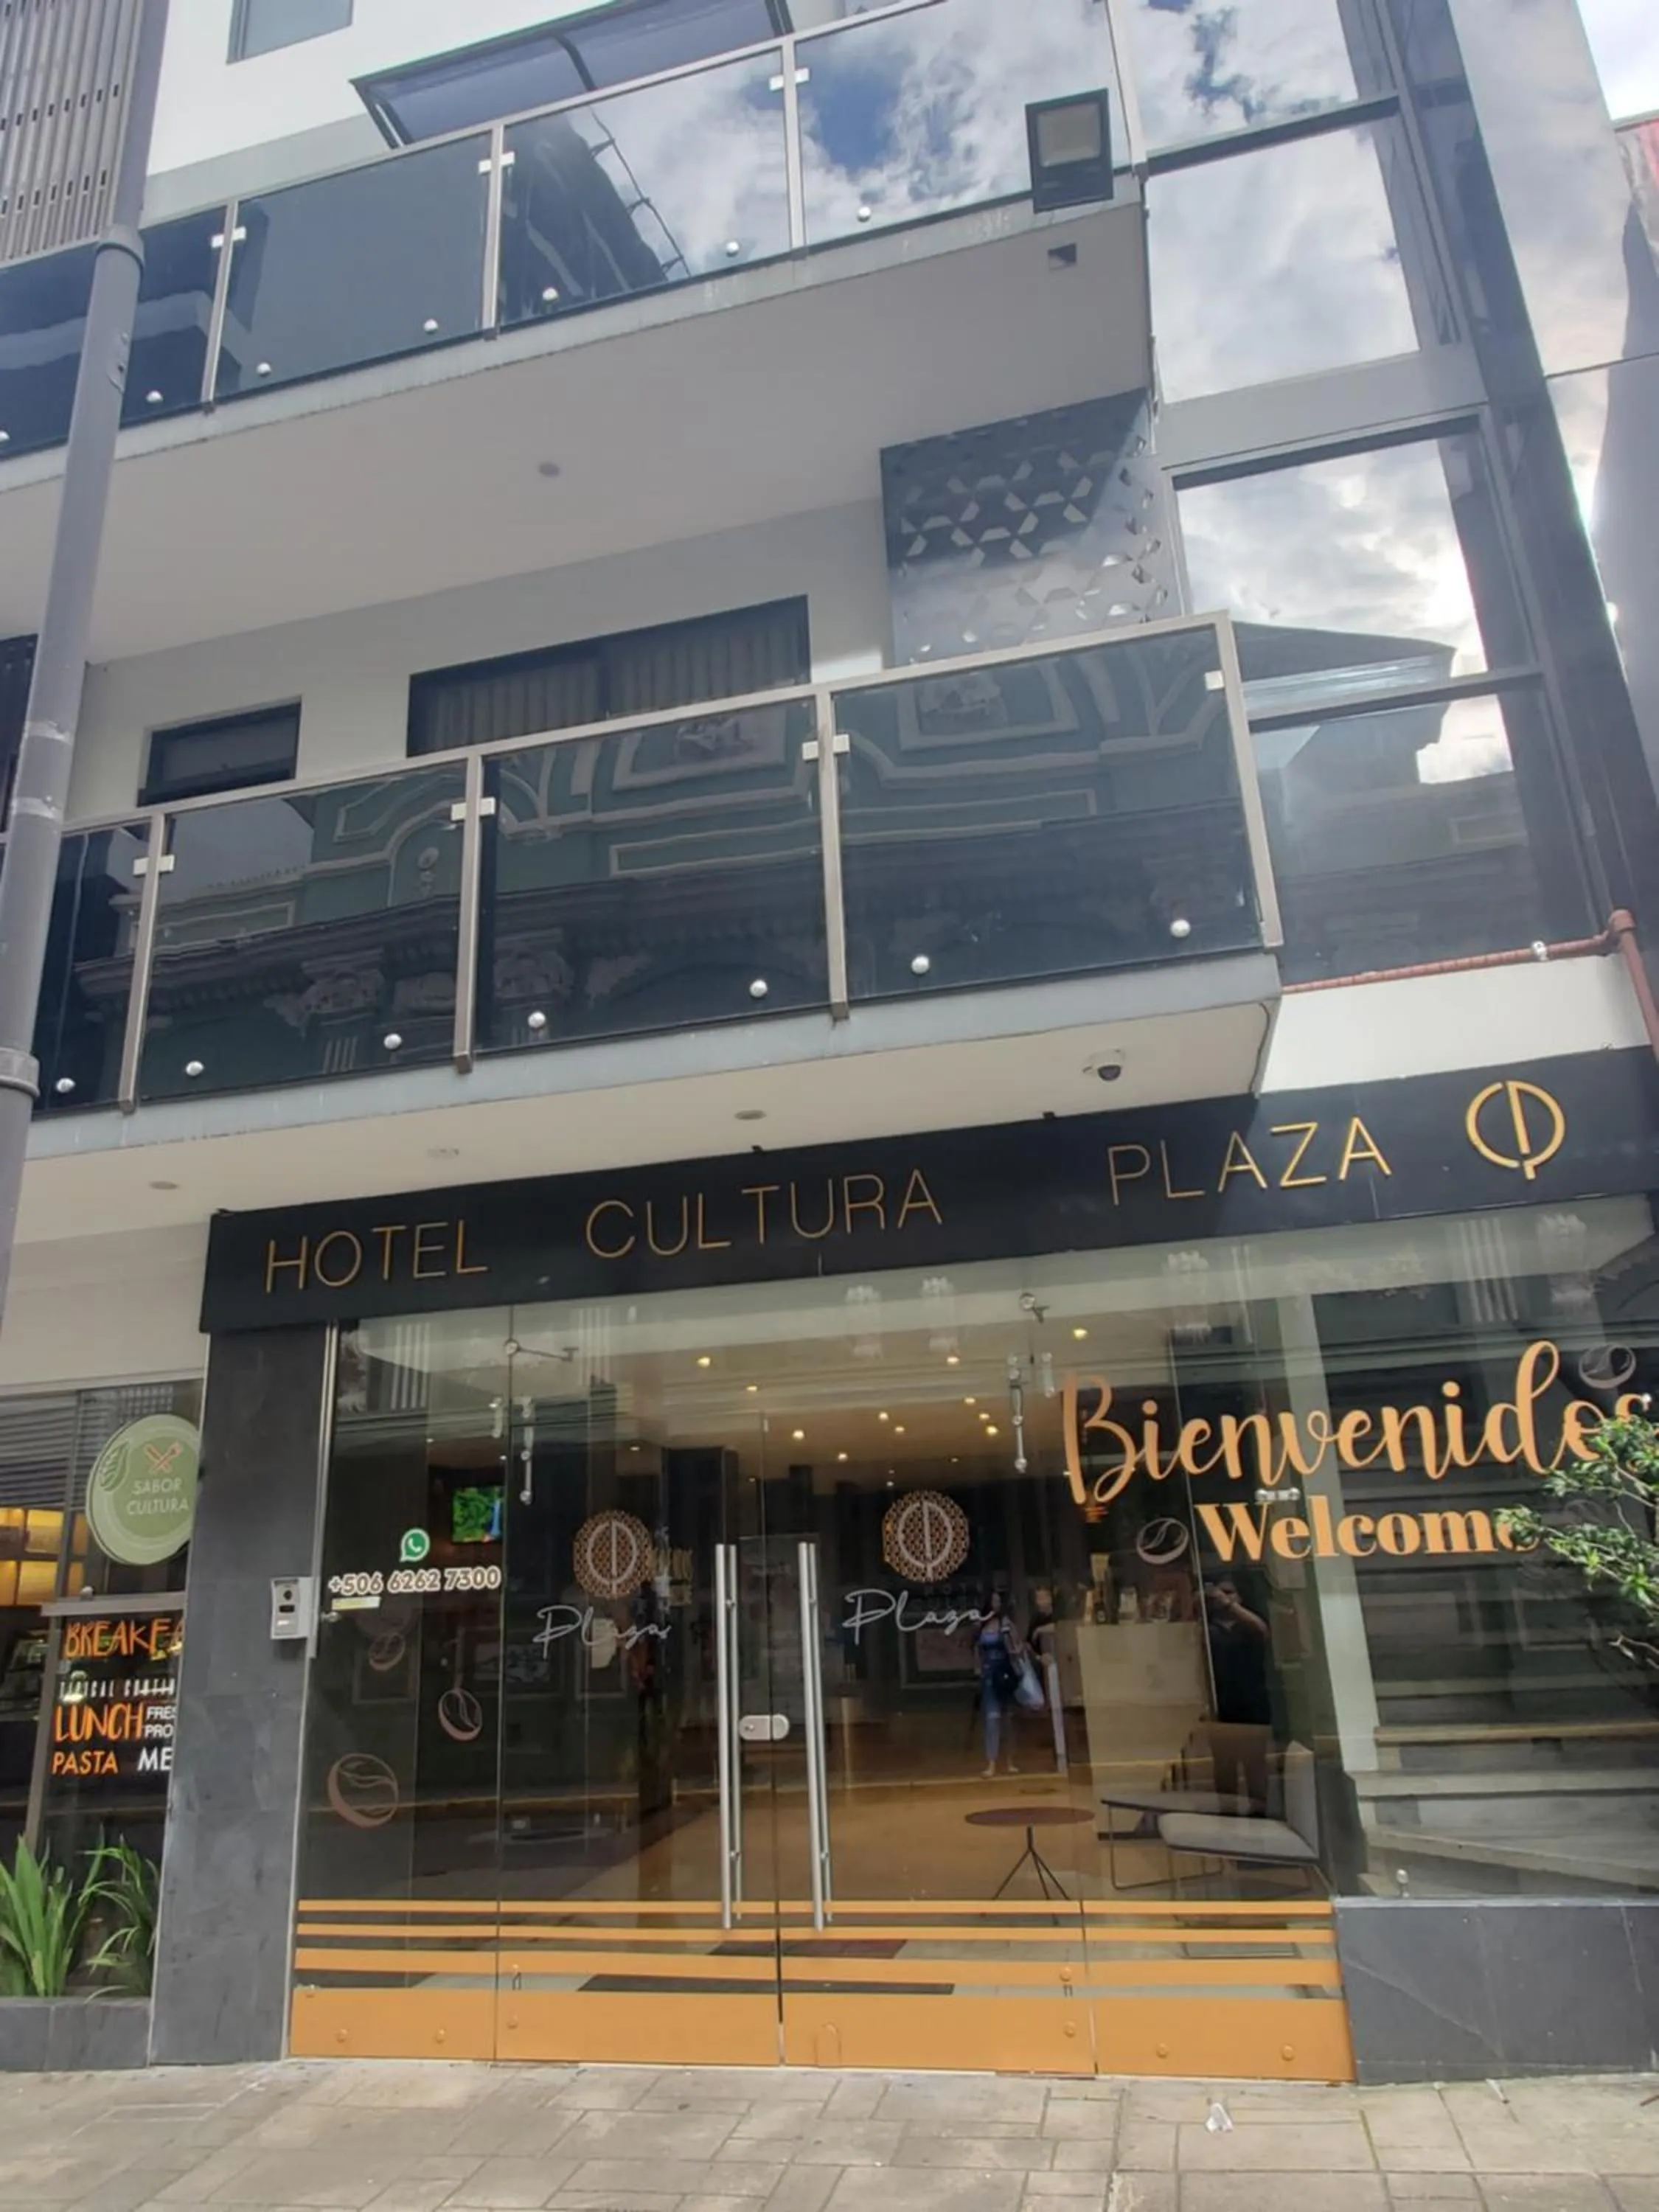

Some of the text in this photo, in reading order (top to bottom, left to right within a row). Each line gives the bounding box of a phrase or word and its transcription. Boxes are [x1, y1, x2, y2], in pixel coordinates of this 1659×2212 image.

[265, 1116, 1392, 1294] HOTEL CULTURA PLAZA
[131, 1478, 183, 1495] SABOR
[126, 1498, 189, 1515] CULTURA
[328, 1565, 502, 1596] +506 6262 7300
[842, 1587, 995, 1646] Plaza
[55, 1702, 144, 1742] LUNCH
[145, 1724, 174, 1738] PRO
[52, 1746, 174, 1775] PASTA ME
